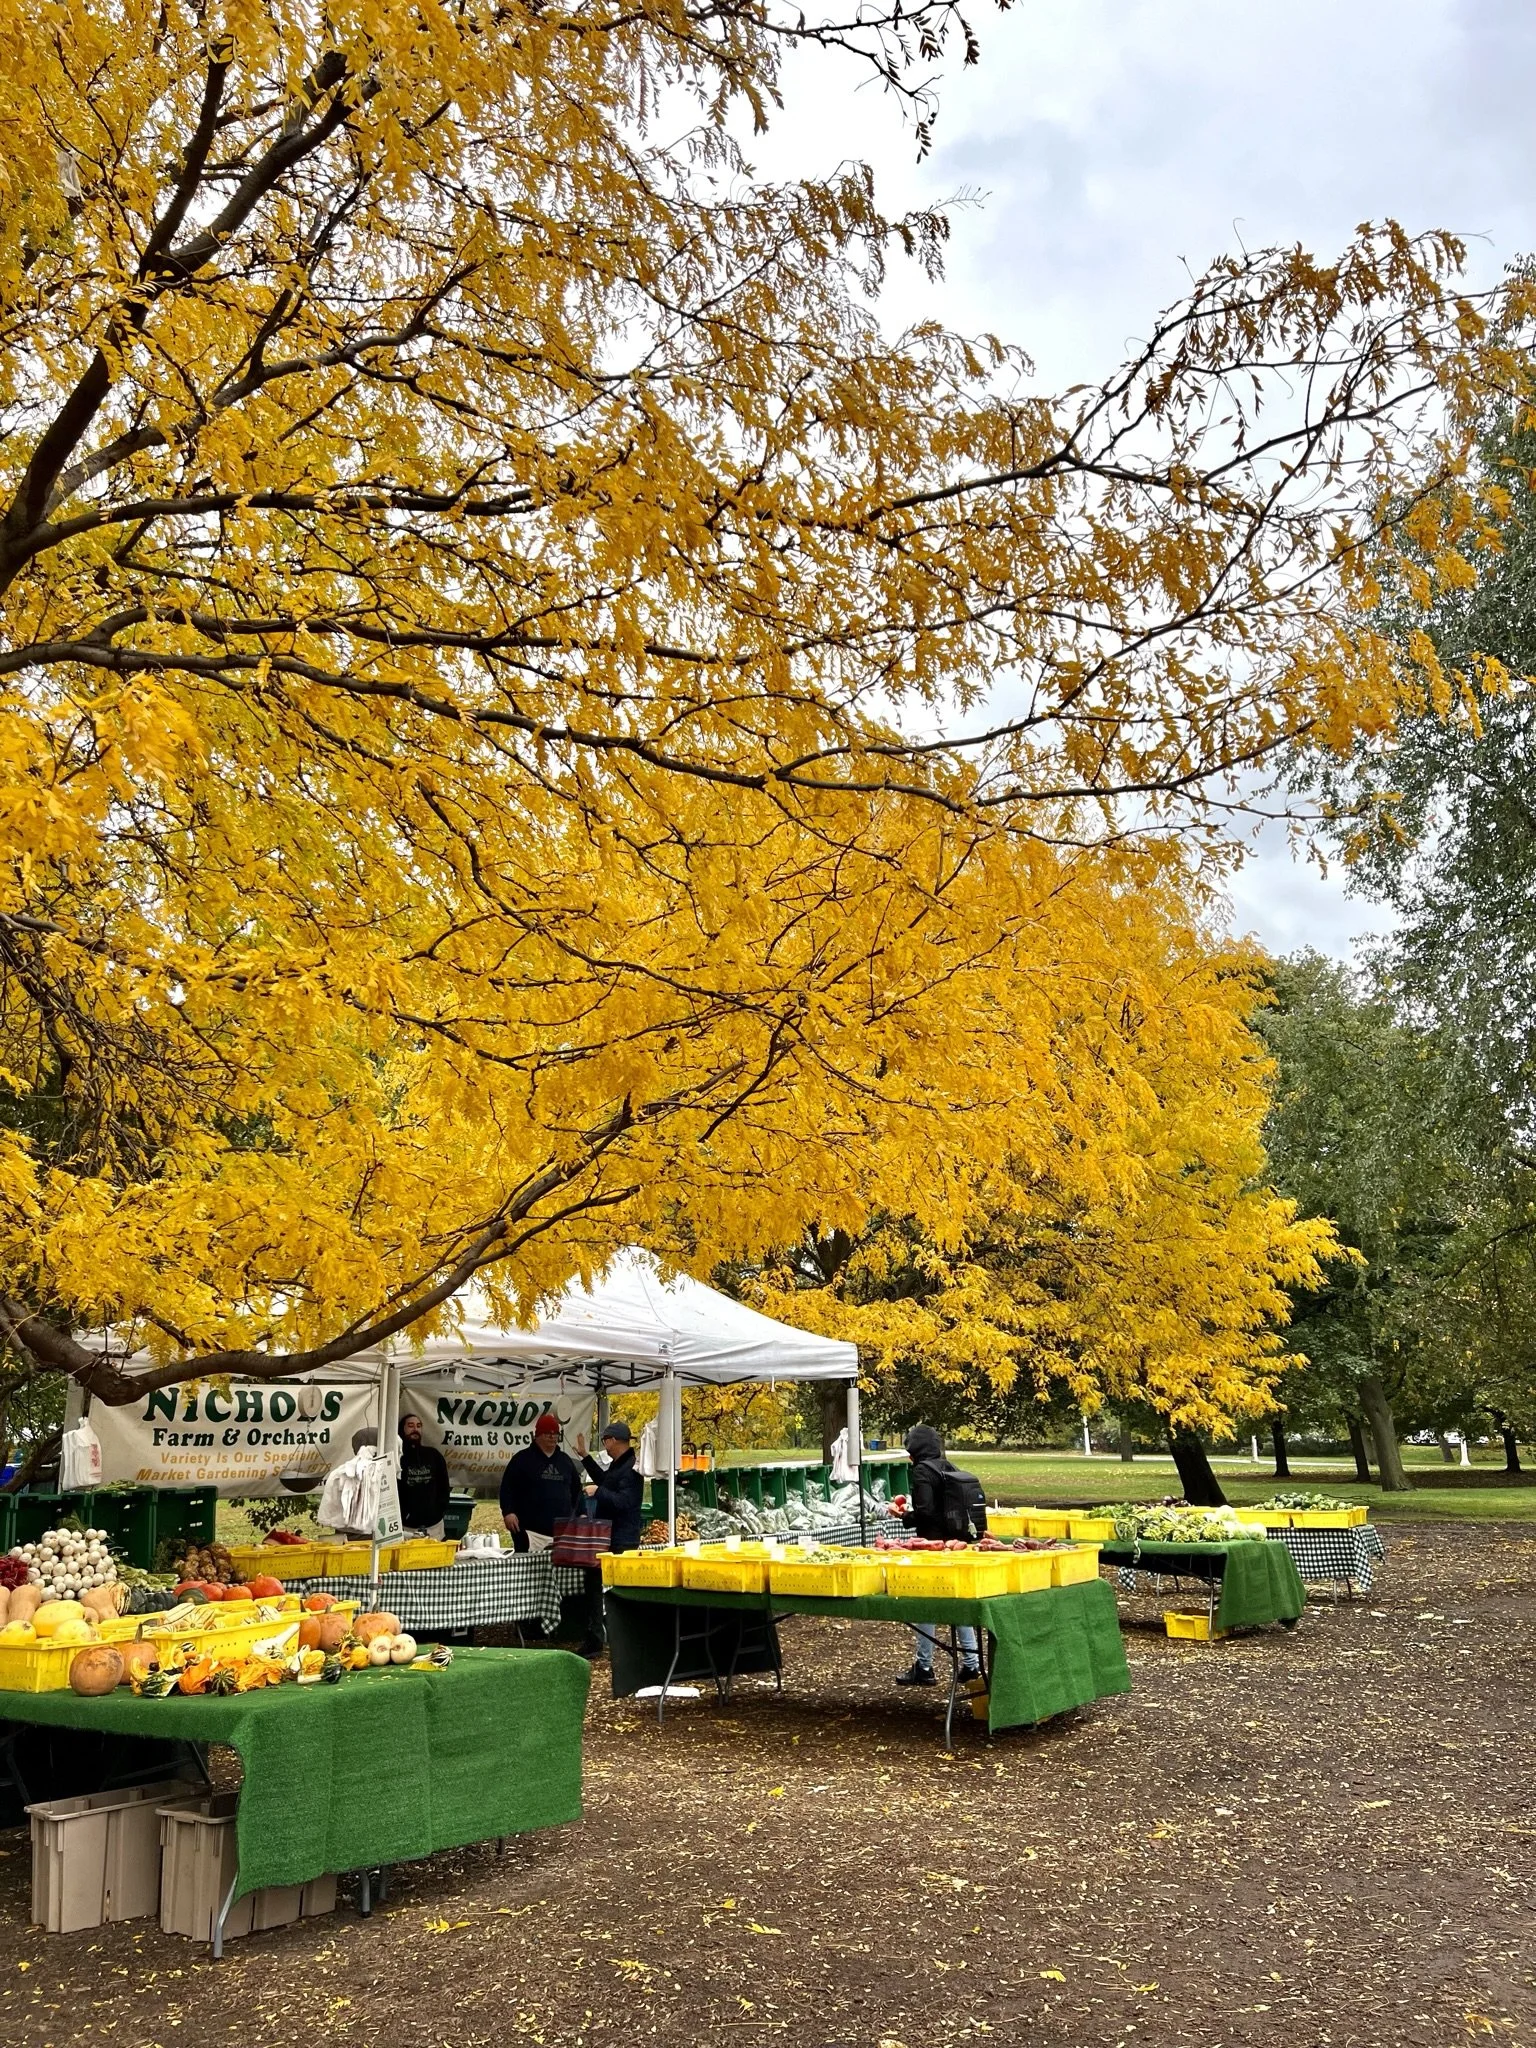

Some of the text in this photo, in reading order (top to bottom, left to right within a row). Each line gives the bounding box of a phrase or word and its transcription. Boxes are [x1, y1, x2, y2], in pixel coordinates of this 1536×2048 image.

[142, 1387, 344, 1423] NICHOS
[437, 1397, 571, 1427] NICHO
[153, 1427, 330, 1447] Farm & Orchard
[441, 1430, 564, 1446] Farm & Orcd
[161, 1451, 211, 1466] Variety
[216, 1452, 228, 1463] Is
[234, 1451, 258, 1463] Our
[444, 1449, 484, 1461] Variety
[136, 1468, 191, 1481] Market
[196, 1467, 267, 1480] Gardening
[467, 1463, 506, 1473] Garden
[388, 1521, 399, 1533] 65
